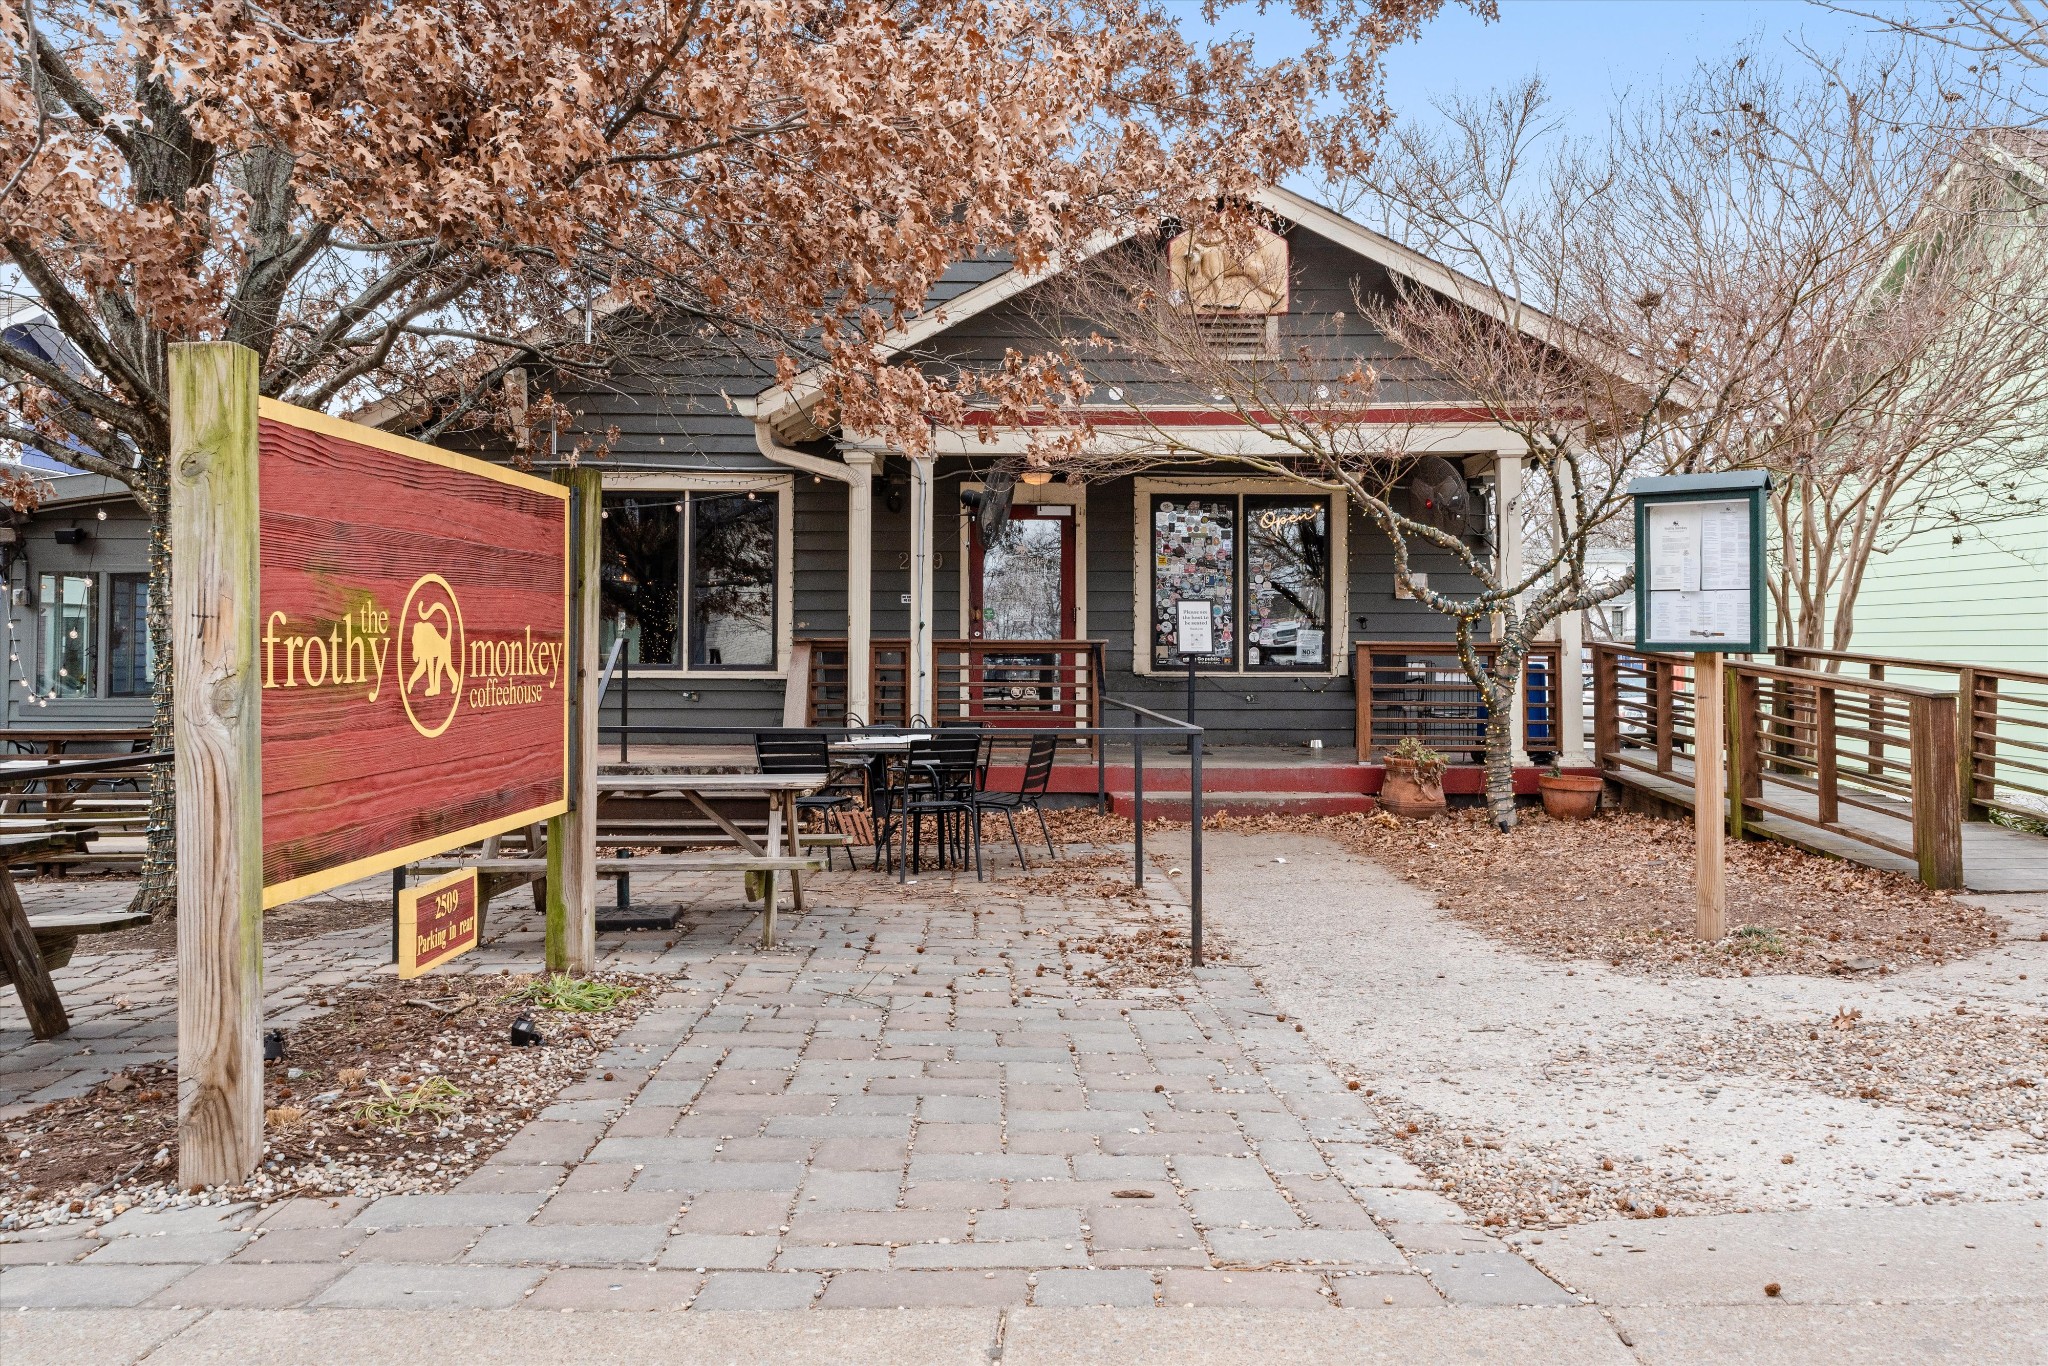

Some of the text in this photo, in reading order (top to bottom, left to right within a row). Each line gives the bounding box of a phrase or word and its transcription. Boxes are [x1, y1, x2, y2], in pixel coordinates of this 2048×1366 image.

[1260, 511, 1316, 535] Open
[360, 600, 388, 634] the
[262, 611, 562, 702] frothy monkey
[470, 678, 542, 708] coffeehouse
[436, 890, 458, 919] 2509
[416, 916, 474, 956] Parking in rear
